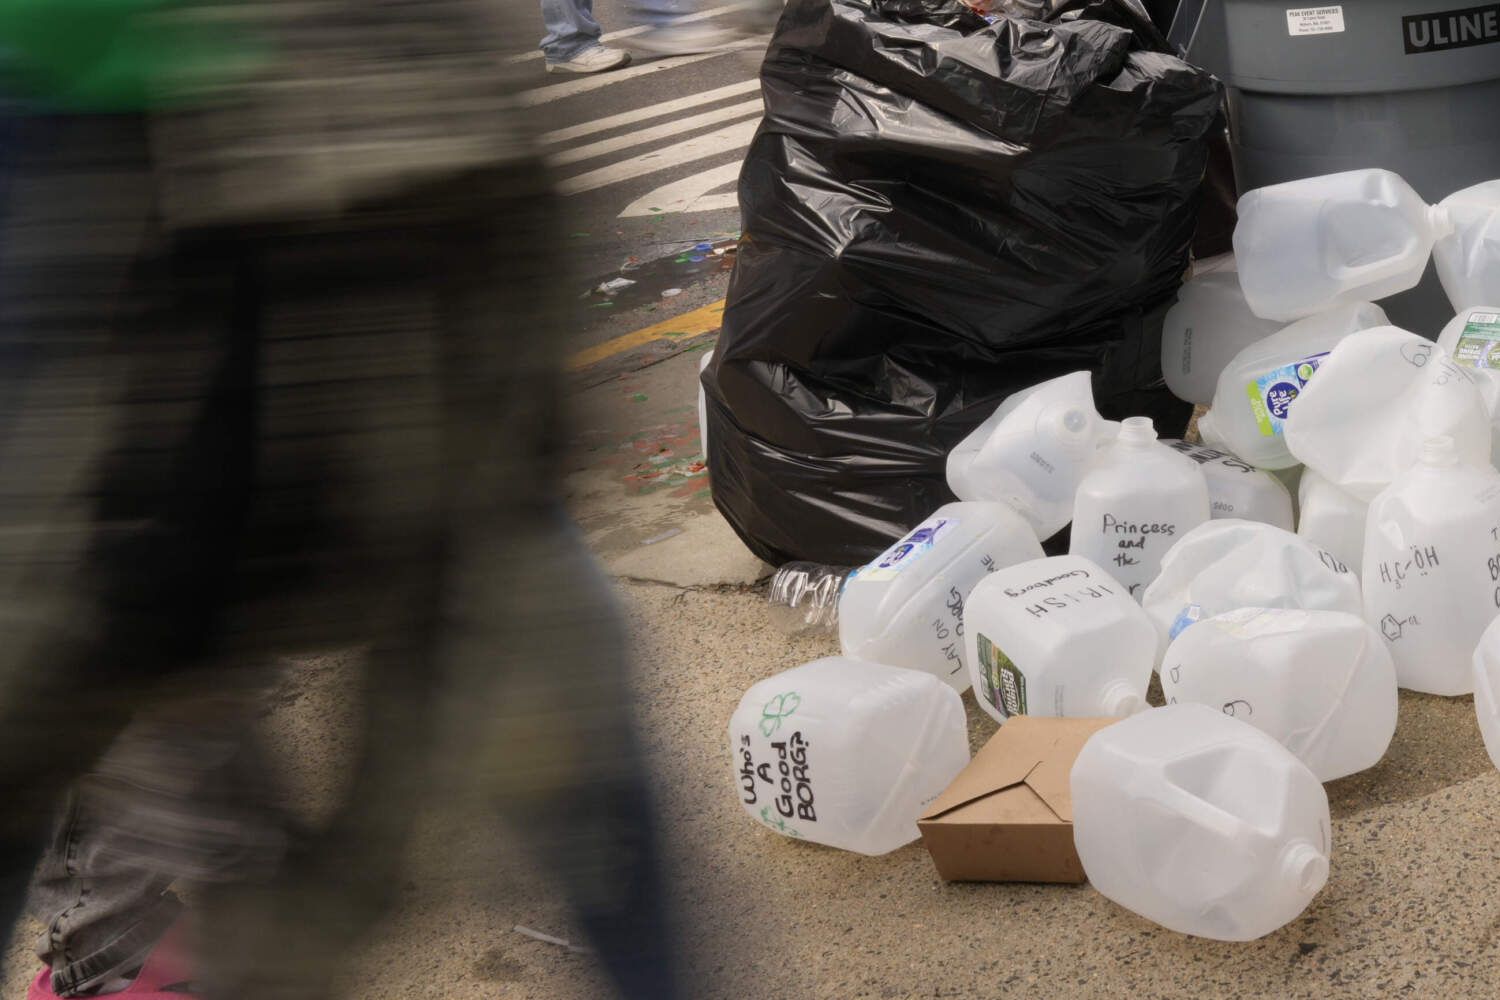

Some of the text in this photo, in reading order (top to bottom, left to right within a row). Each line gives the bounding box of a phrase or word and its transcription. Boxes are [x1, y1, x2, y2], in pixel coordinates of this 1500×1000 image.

[1408, 10, 1499, 47] ULINE
[1270, 390, 1283, 416] Pure
[1103, 513, 1175, 536] Princess
[1118, 536, 1146, 549] and
[1113, 552, 1141, 567] the
[1025, 585, 1114, 618] IRISH
[932, 618, 963, 675] LAY ON
[739, 734, 757, 805] Who's
[757, 762, 774, 785] A
[771, 741, 794, 818] Good
[789, 731, 817, 822] BORG?
